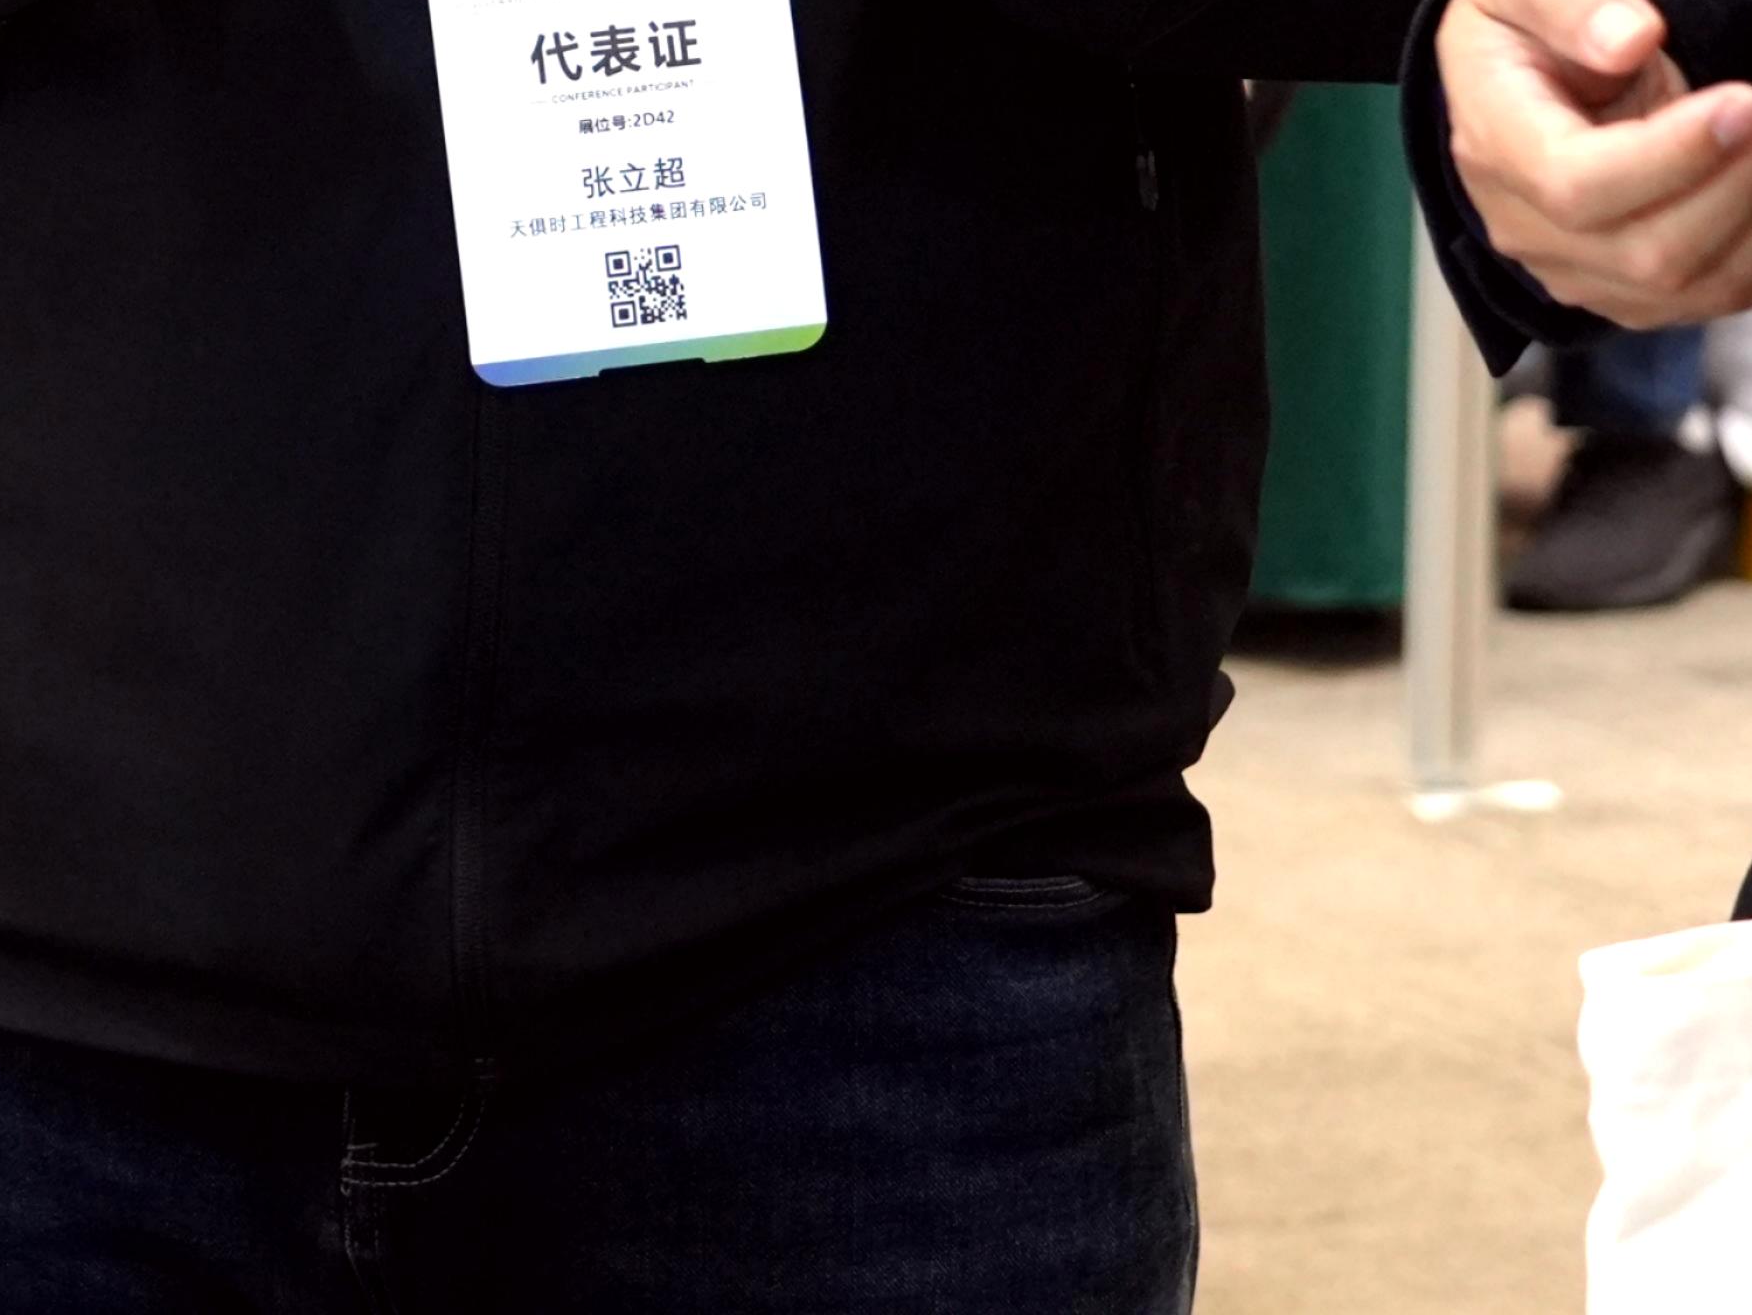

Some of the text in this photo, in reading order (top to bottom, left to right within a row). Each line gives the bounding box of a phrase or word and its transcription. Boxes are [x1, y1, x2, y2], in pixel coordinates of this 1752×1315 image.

[530, 19, 702, 84] 代表证
[552, 79, 694, 104] CONFERENCE PARTICIPANT
[581, 156, 687, 199] 张立超
[509, 191, 769, 239] 天俱时工程科技集团有限公司
